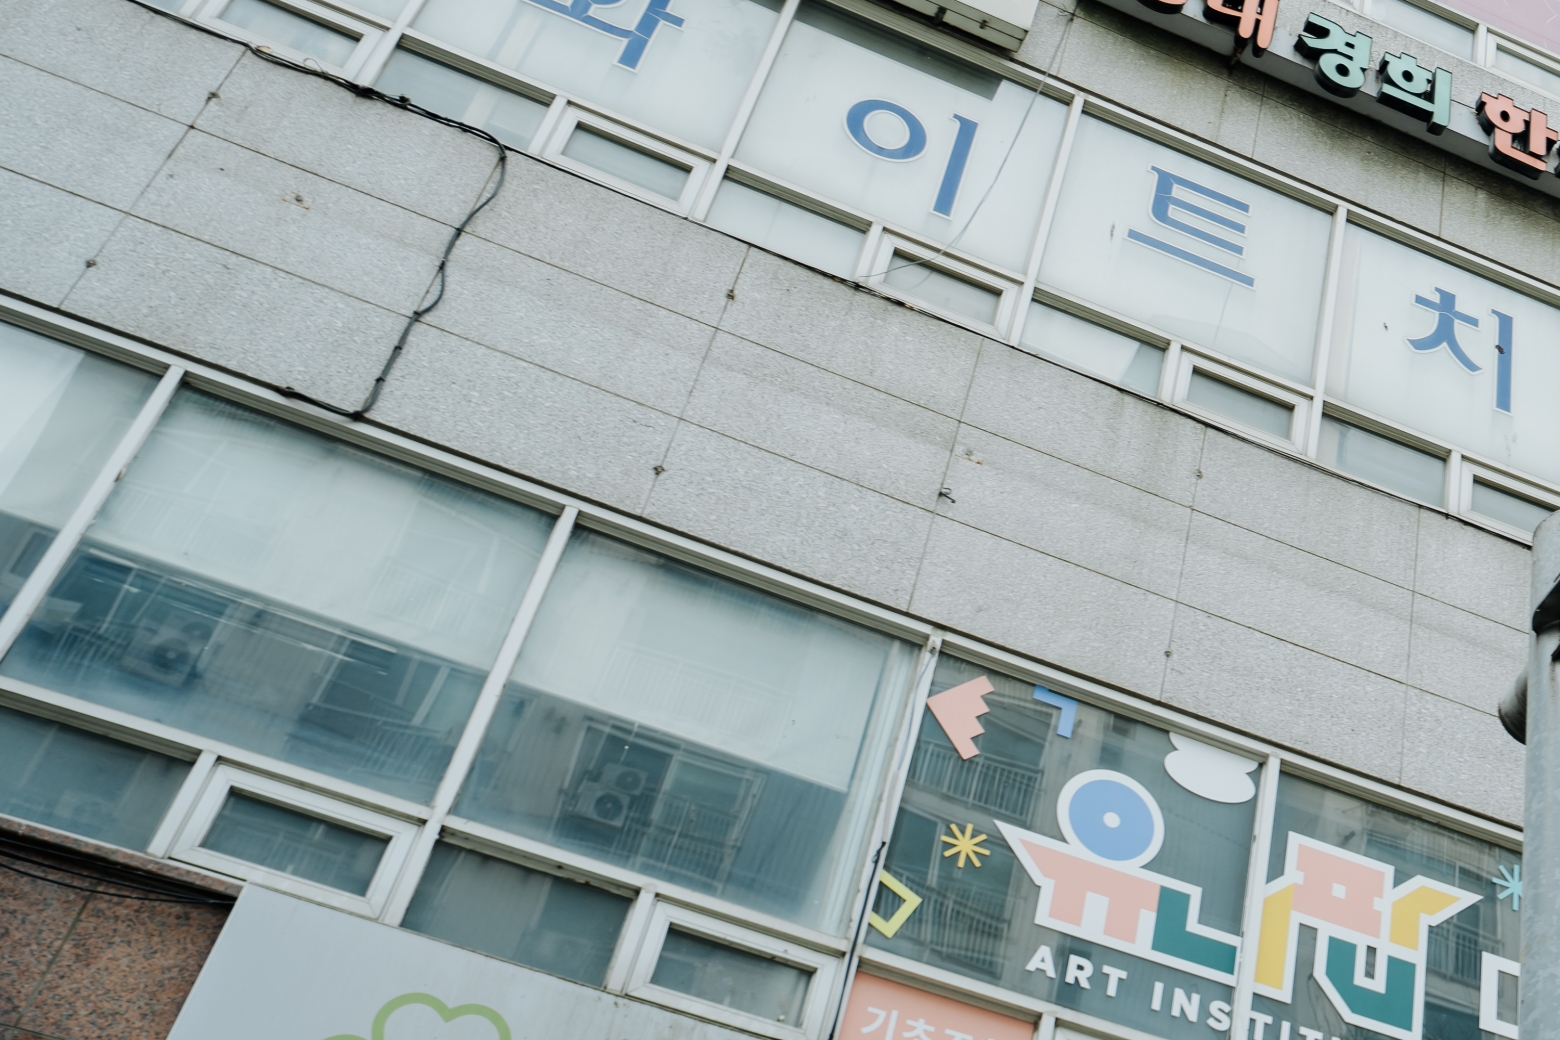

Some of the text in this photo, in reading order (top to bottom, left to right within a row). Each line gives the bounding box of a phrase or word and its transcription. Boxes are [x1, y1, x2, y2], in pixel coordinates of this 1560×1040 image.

[1294, 12, 1452, 134] 경희
[1025, 945, 1340, 1040] ART INSTI
